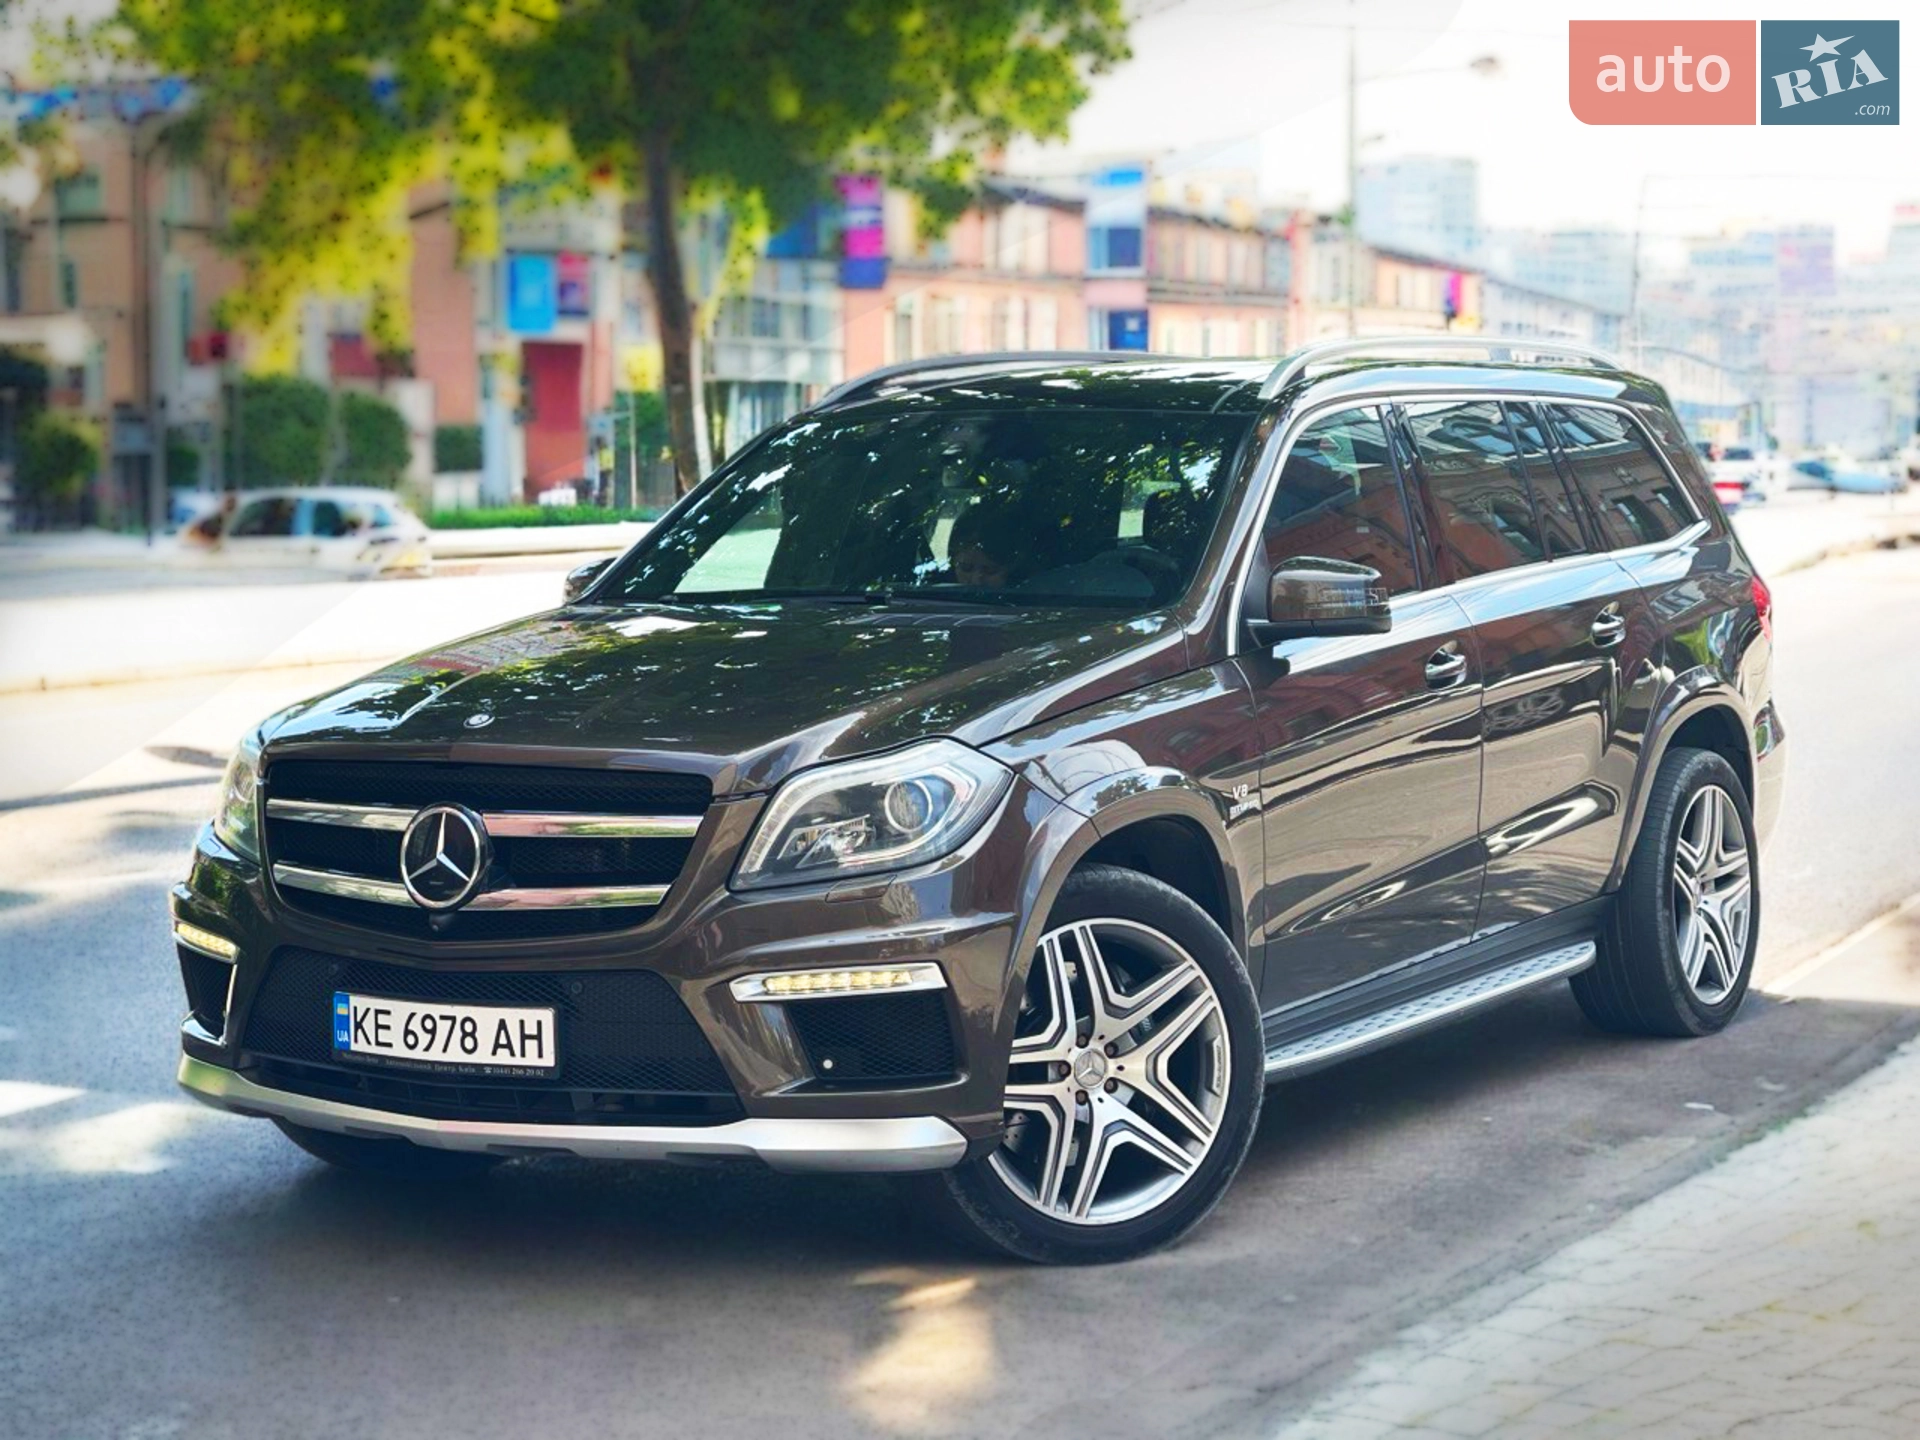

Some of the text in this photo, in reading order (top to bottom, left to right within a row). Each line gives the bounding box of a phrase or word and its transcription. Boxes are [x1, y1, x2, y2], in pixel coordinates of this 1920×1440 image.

[1232, 783, 1249, 800] V8
[337, 1029, 349, 1042] UA
[353, 1005, 544, 1059] KE 6978 AH
